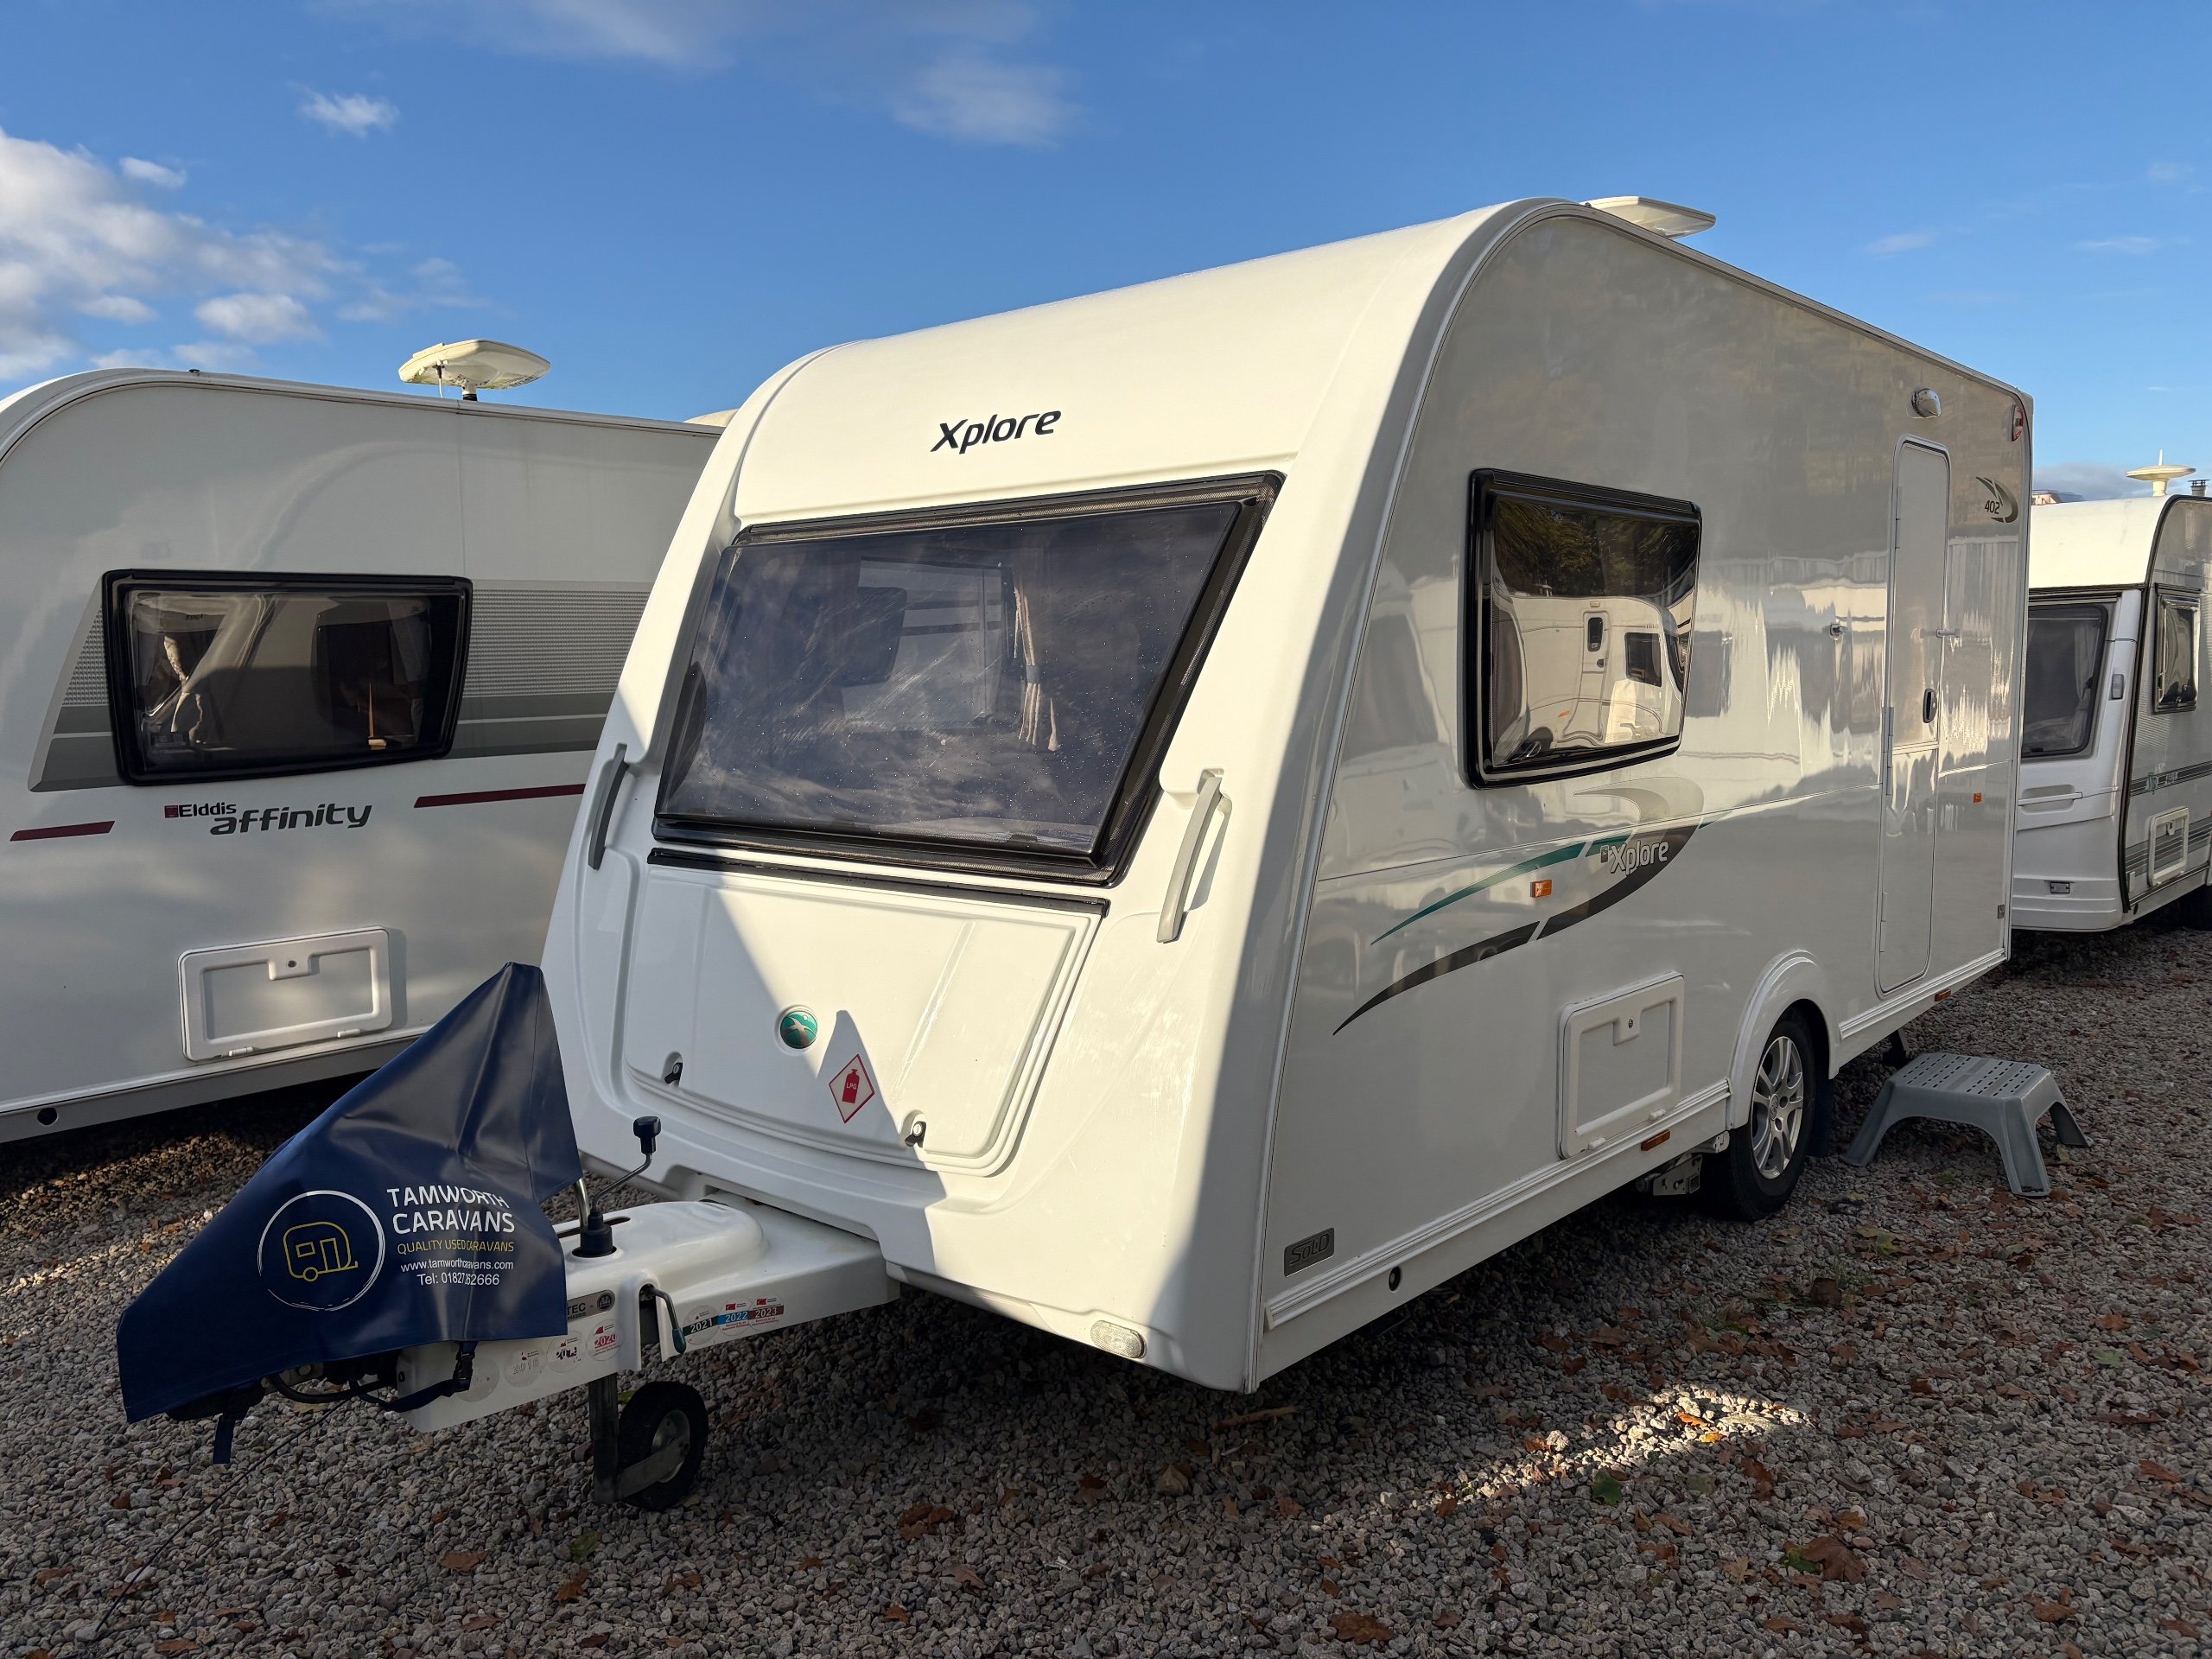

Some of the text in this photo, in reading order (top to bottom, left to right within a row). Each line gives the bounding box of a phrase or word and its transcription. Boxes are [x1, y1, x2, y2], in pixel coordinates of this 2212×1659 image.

[929, 410, 1062, 455] Xplore
[1984, 499, 2001, 515] 402
[178, 802, 238, 818] Elddis
[209, 803, 373, 836] affinity
[1609, 839, 1670, 877] Xplore
[846, 1082, 858, 1090] LPG
[386, 1185, 511, 1209] TAMWORTH
[392, 1209, 516, 1235] CARAVANS
[397, 1239, 515, 1255] QUALITY USED CARAVANS
[416, 1273, 439, 1287] Tel:
[725, 1311, 748, 1324] 2022
[754, 1306, 778, 1319] 2023
[690, 1318, 714, 1333] 2021
